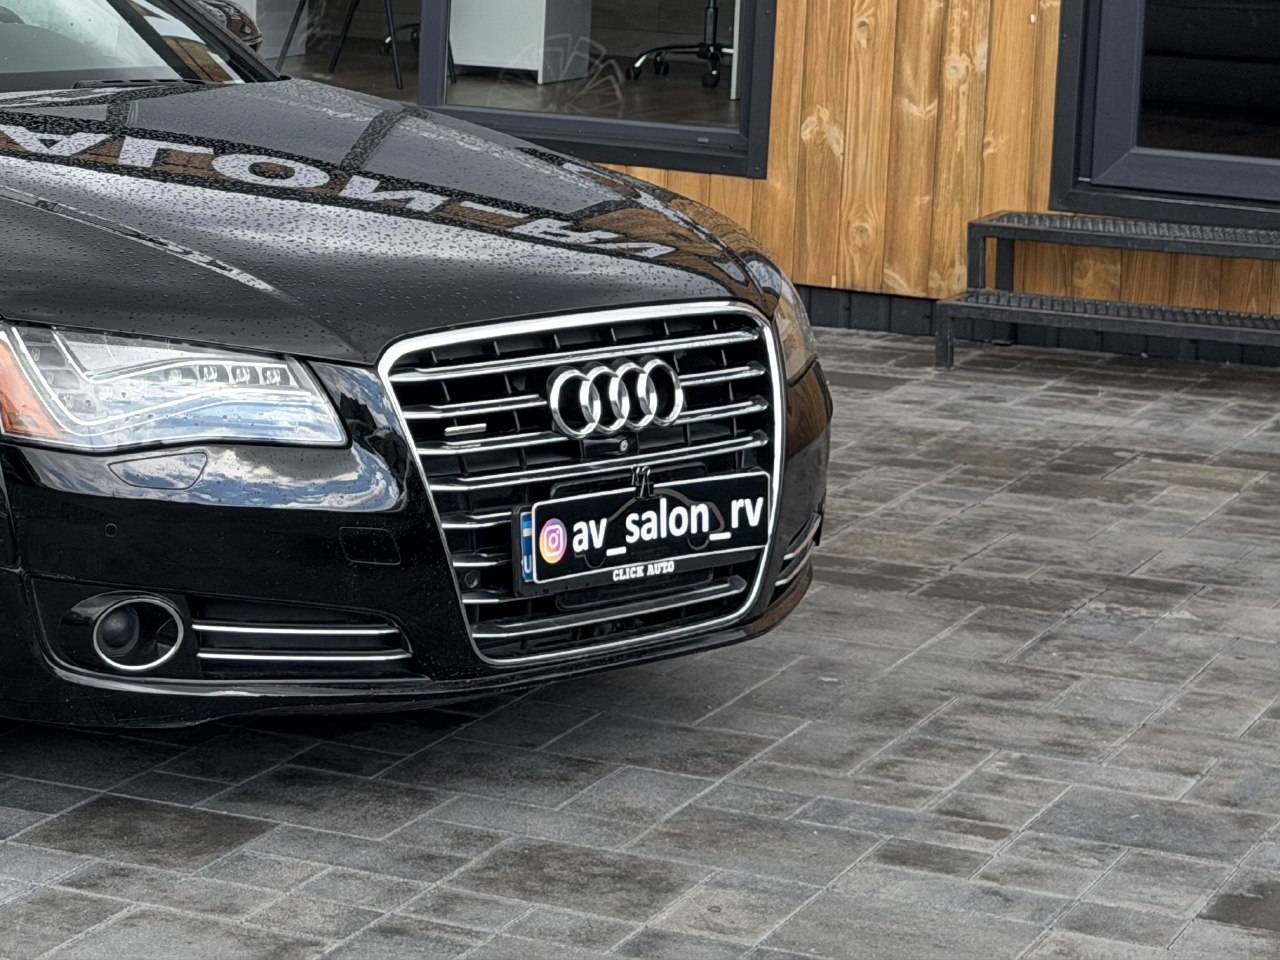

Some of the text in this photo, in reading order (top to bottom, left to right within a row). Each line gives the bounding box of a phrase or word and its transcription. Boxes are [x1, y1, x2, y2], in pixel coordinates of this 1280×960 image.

[572, 497, 763, 556] av_salon_rv
[612, 560, 676, 582] CLICK AUTO
